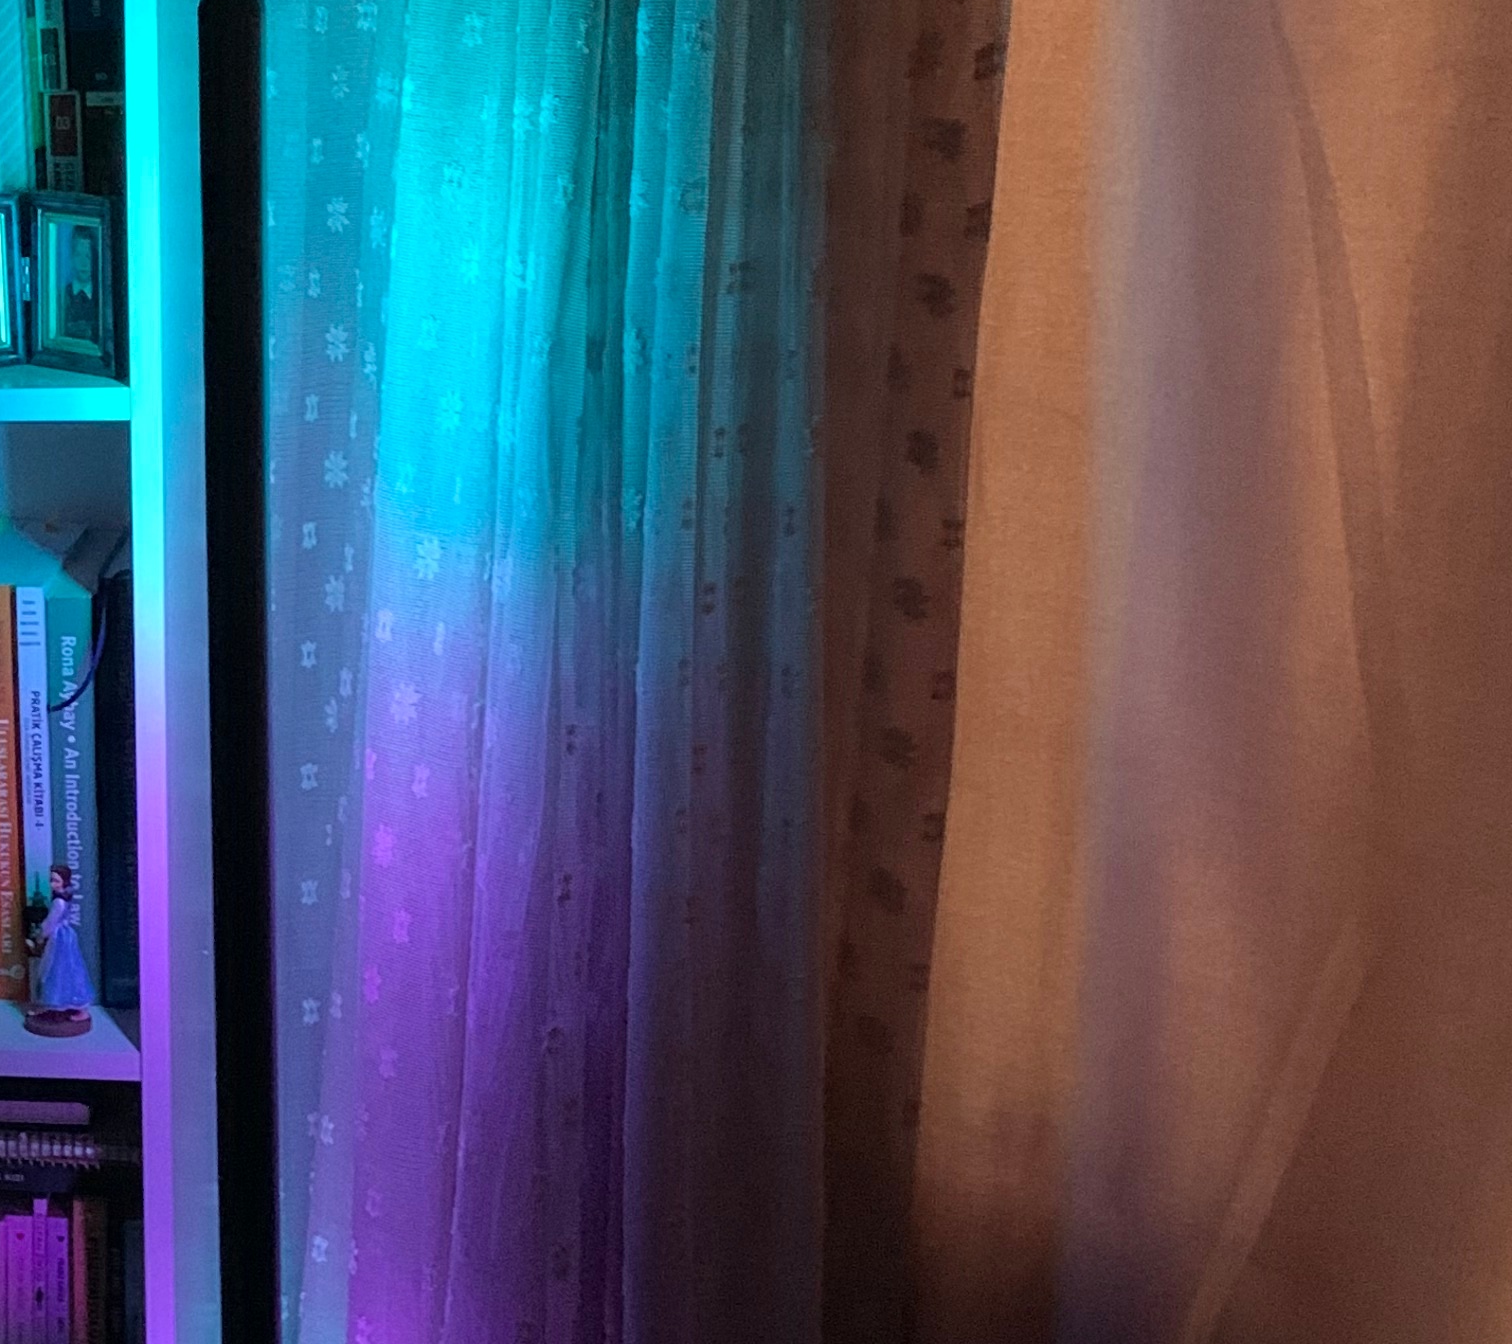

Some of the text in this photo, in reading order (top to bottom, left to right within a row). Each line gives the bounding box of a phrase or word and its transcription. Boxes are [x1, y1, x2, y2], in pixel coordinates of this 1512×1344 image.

[60, 635, 77, 677] Rona
[29, 691, 45, 730] PRATİK
[30, 732, 45, 780] ÇALIŞMA
[64, 747, 80, 769] An
[33, 782, 46, 818] KİTABI
[65, 773, 84, 871] Introduction
